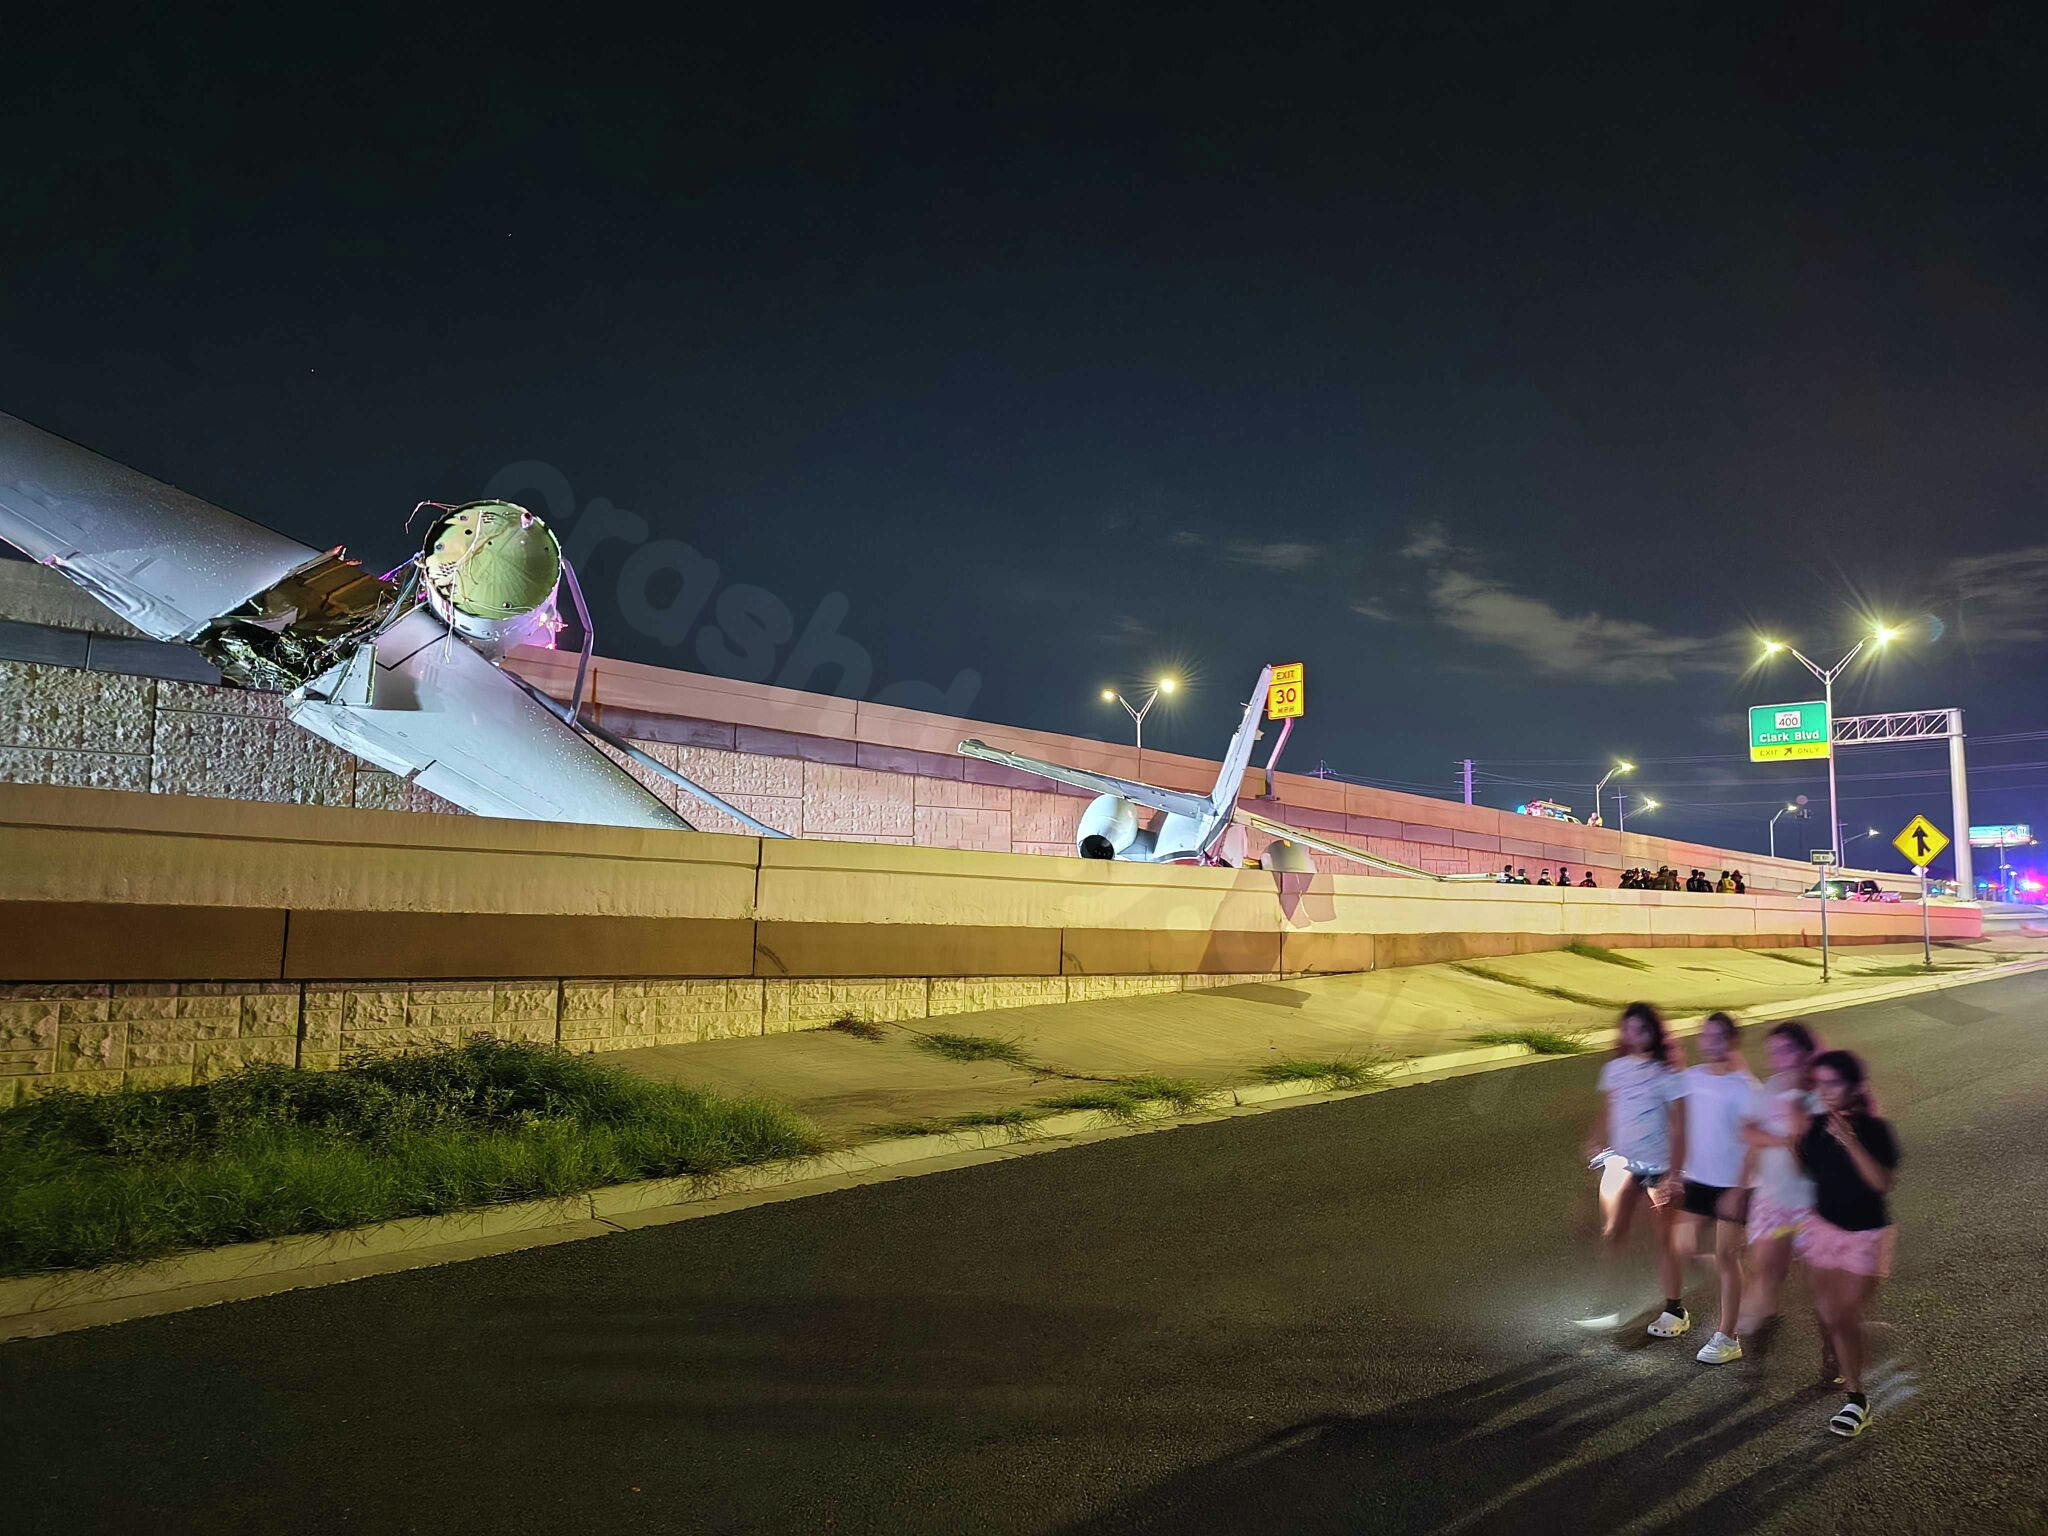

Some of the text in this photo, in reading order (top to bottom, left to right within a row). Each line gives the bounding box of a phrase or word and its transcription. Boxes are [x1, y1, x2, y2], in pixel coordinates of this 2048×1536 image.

[1276, 670, 1295, 680] EXIT
[1276, 688, 1296, 704] 30
[1778, 717, 1798, 726] 400
[1759, 730, 1819, 743] Clark Blvd
[1760, 749, 1777, 757] EXIT
